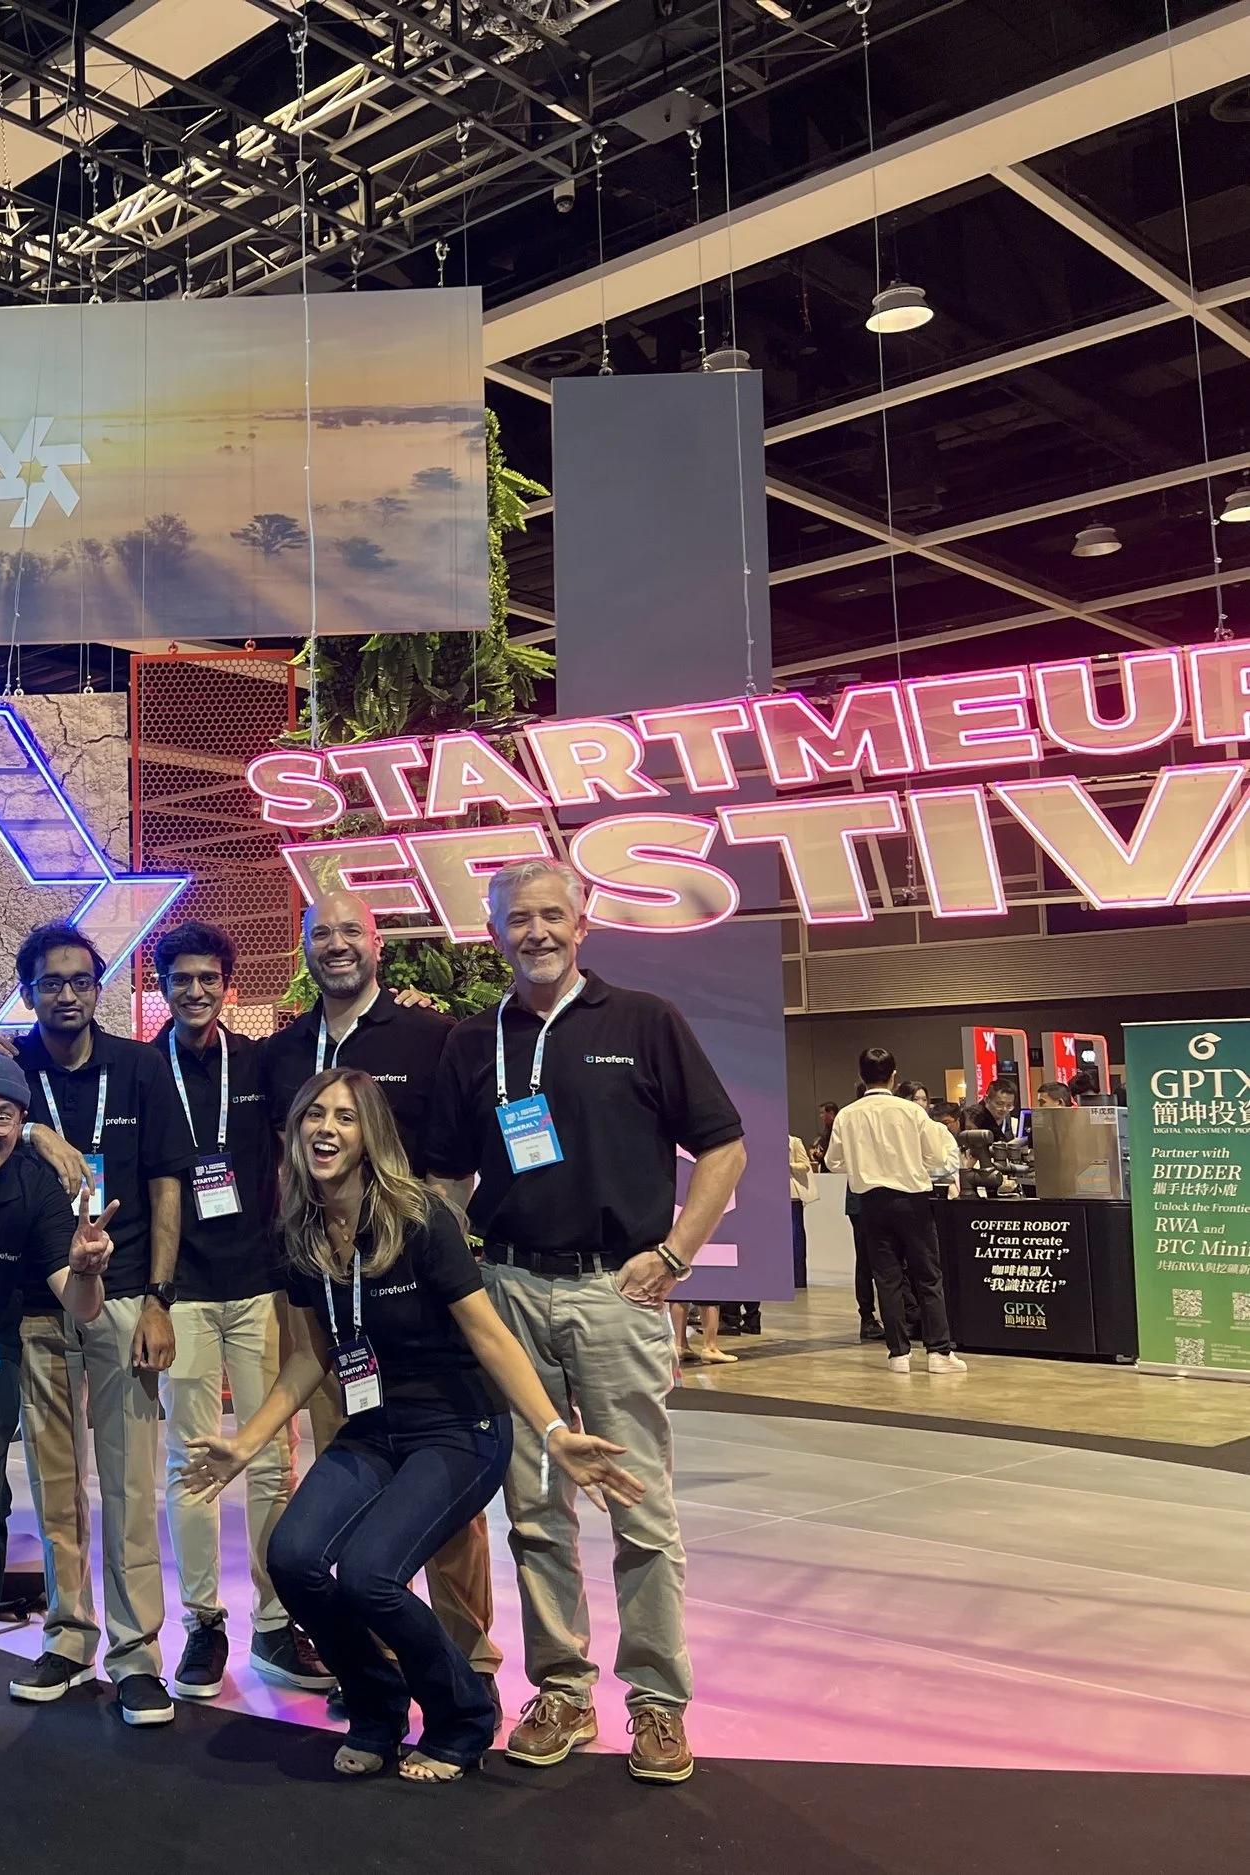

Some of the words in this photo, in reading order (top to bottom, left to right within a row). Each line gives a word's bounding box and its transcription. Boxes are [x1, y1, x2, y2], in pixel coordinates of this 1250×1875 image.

[277, 759, 1250, 944] FESTIV
[105, 1117, 137, 1126] preferrd
[503, 1122, 535, 1135] GENERAL
[1151, 1147, 1200, 1158] Partner
[1202, 1147, 1230, 1159] with
[1151, 1164, 1242, 1181] BITDEER
[192, 1175, 219, 1186] STARTUP
[1154, 1201, 1190, 1211] Unlock
[1192, 1202, 1210, 1212] the
[970, 1219, 1021, 1231] COFFEE
[1022, 1221, 1071, 1232] ROBOT
[1154, 1216, 1200, 1234] RWA
[1203, 1224, 1226, 1235] and
[996, 1236, 1020, 1245] can
[1022, 1236, 1063, 1246] create
[1155, 1238, 1196, 1255] BTC
[974, 1247, 1021, 1259] LATTE
[991, 1264, 1053, 1278] 咖啡機器人
[379, 1280, 418, 1297] preferrd
[1003, 1301, 1046, 1316] GPTX
[338, 1365, 363, 1378] STARTUP
